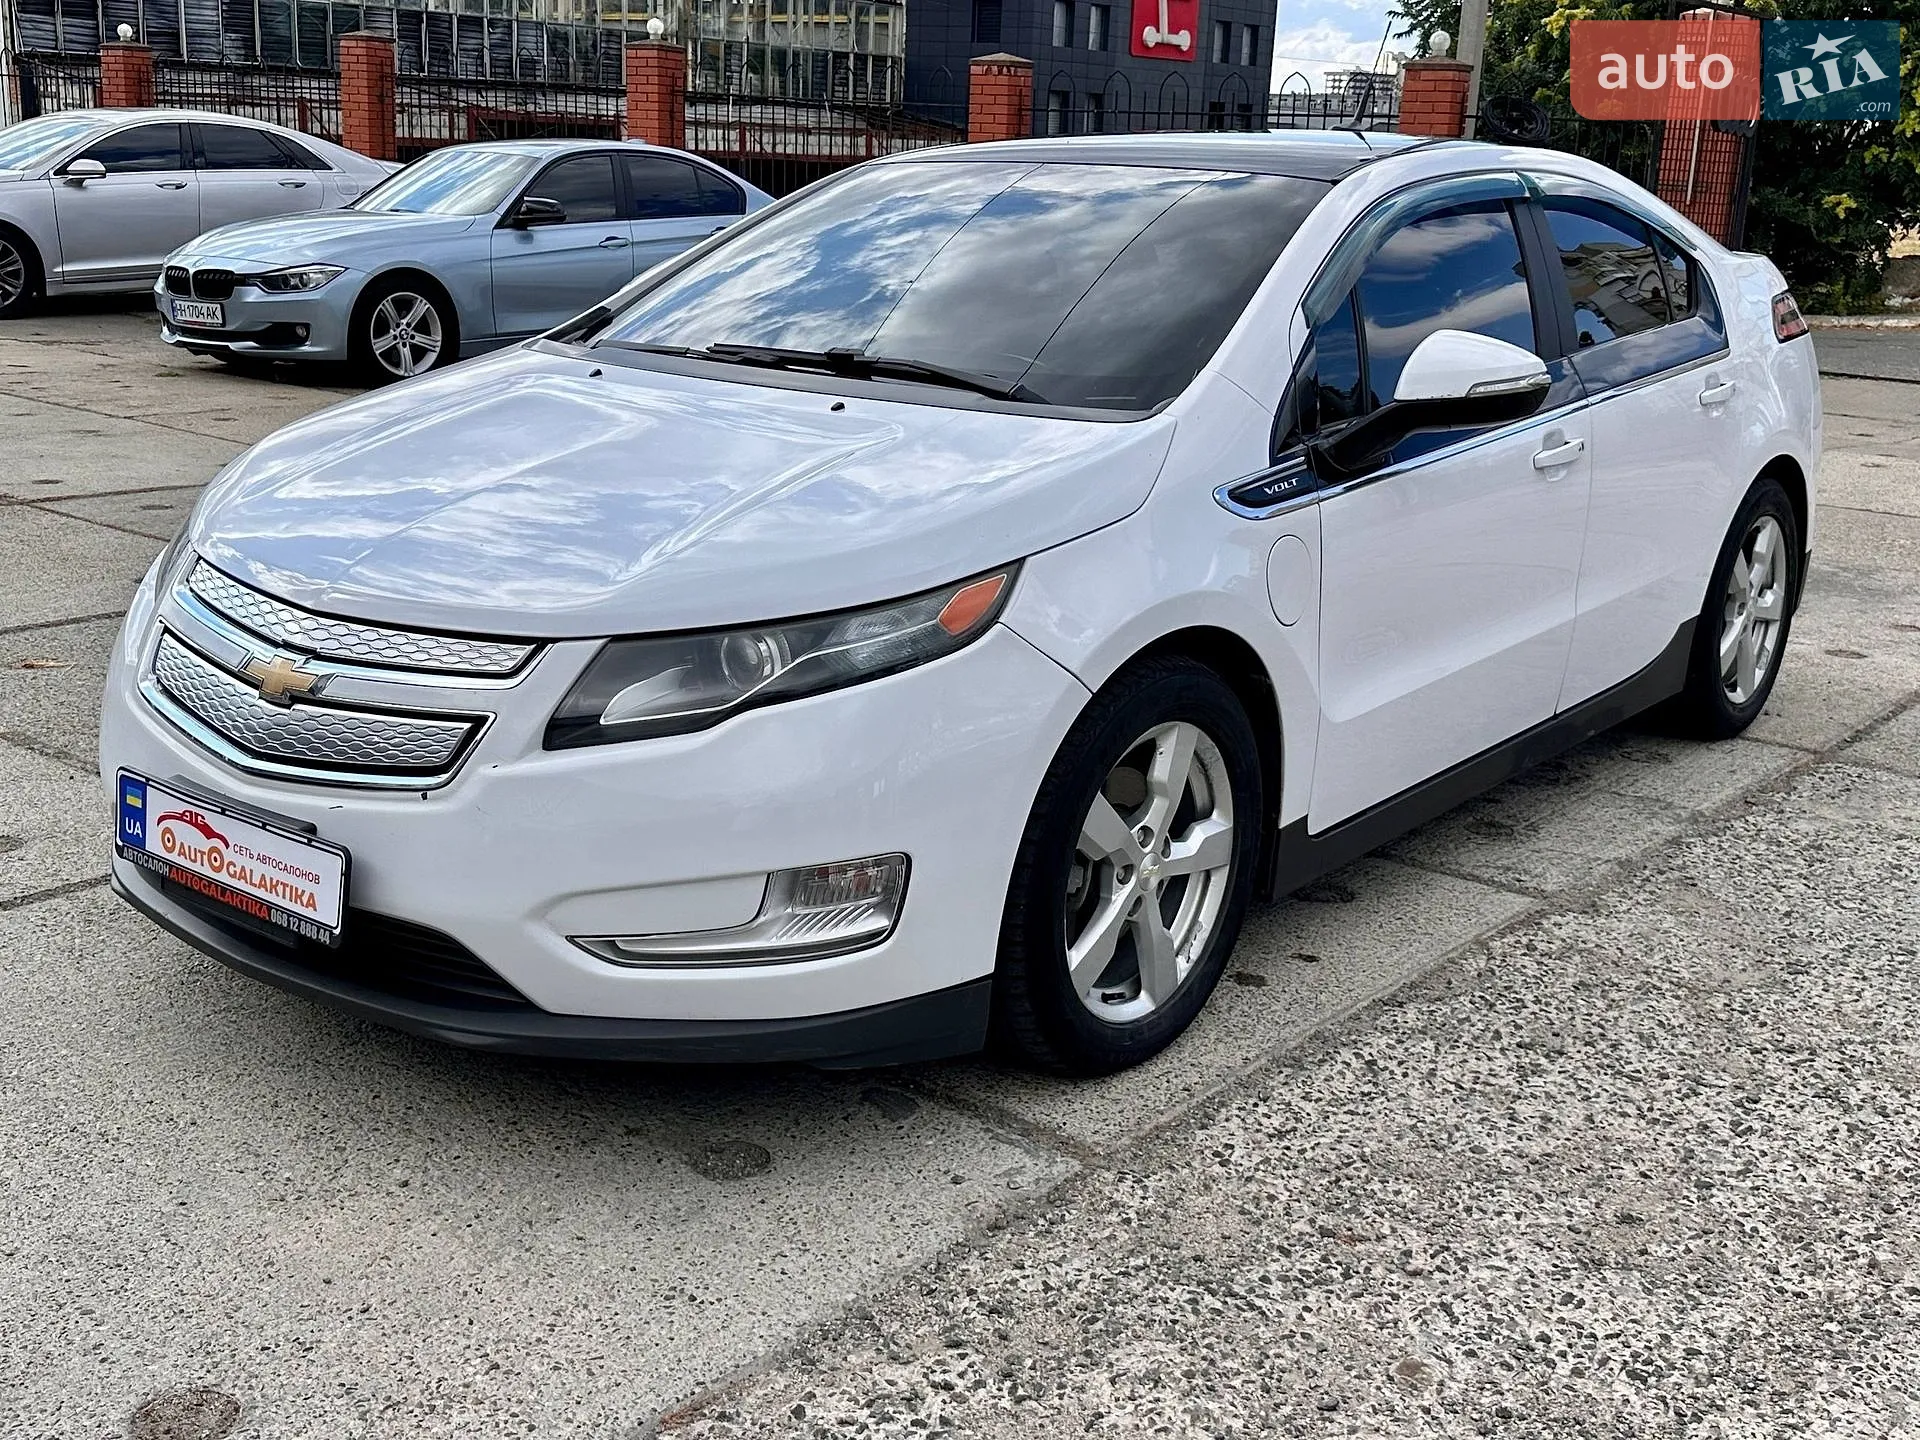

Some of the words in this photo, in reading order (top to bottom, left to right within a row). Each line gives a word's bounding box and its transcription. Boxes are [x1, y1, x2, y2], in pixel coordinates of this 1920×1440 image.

[187, 304, 205, 319] 1704
[206, 306, 220, 320] AK
[1263, 478, 1299, 495] VOLT
[125, 816, 143, 838] UA
[123, 846, 169, 877] АВТОСАЛОН
[233, 843, 254, 860] СЕТЬ
[256, 852, 320, 885] АВТОСАЛОНОВ
[169, 867, 269, 920] AUTOGALAKTIKA
[271, 909, 288, 928] 068
[289, 916, 299, 932] 12
[300, 921, 317, 939] 888
[318, 930, 330, 945] 44
